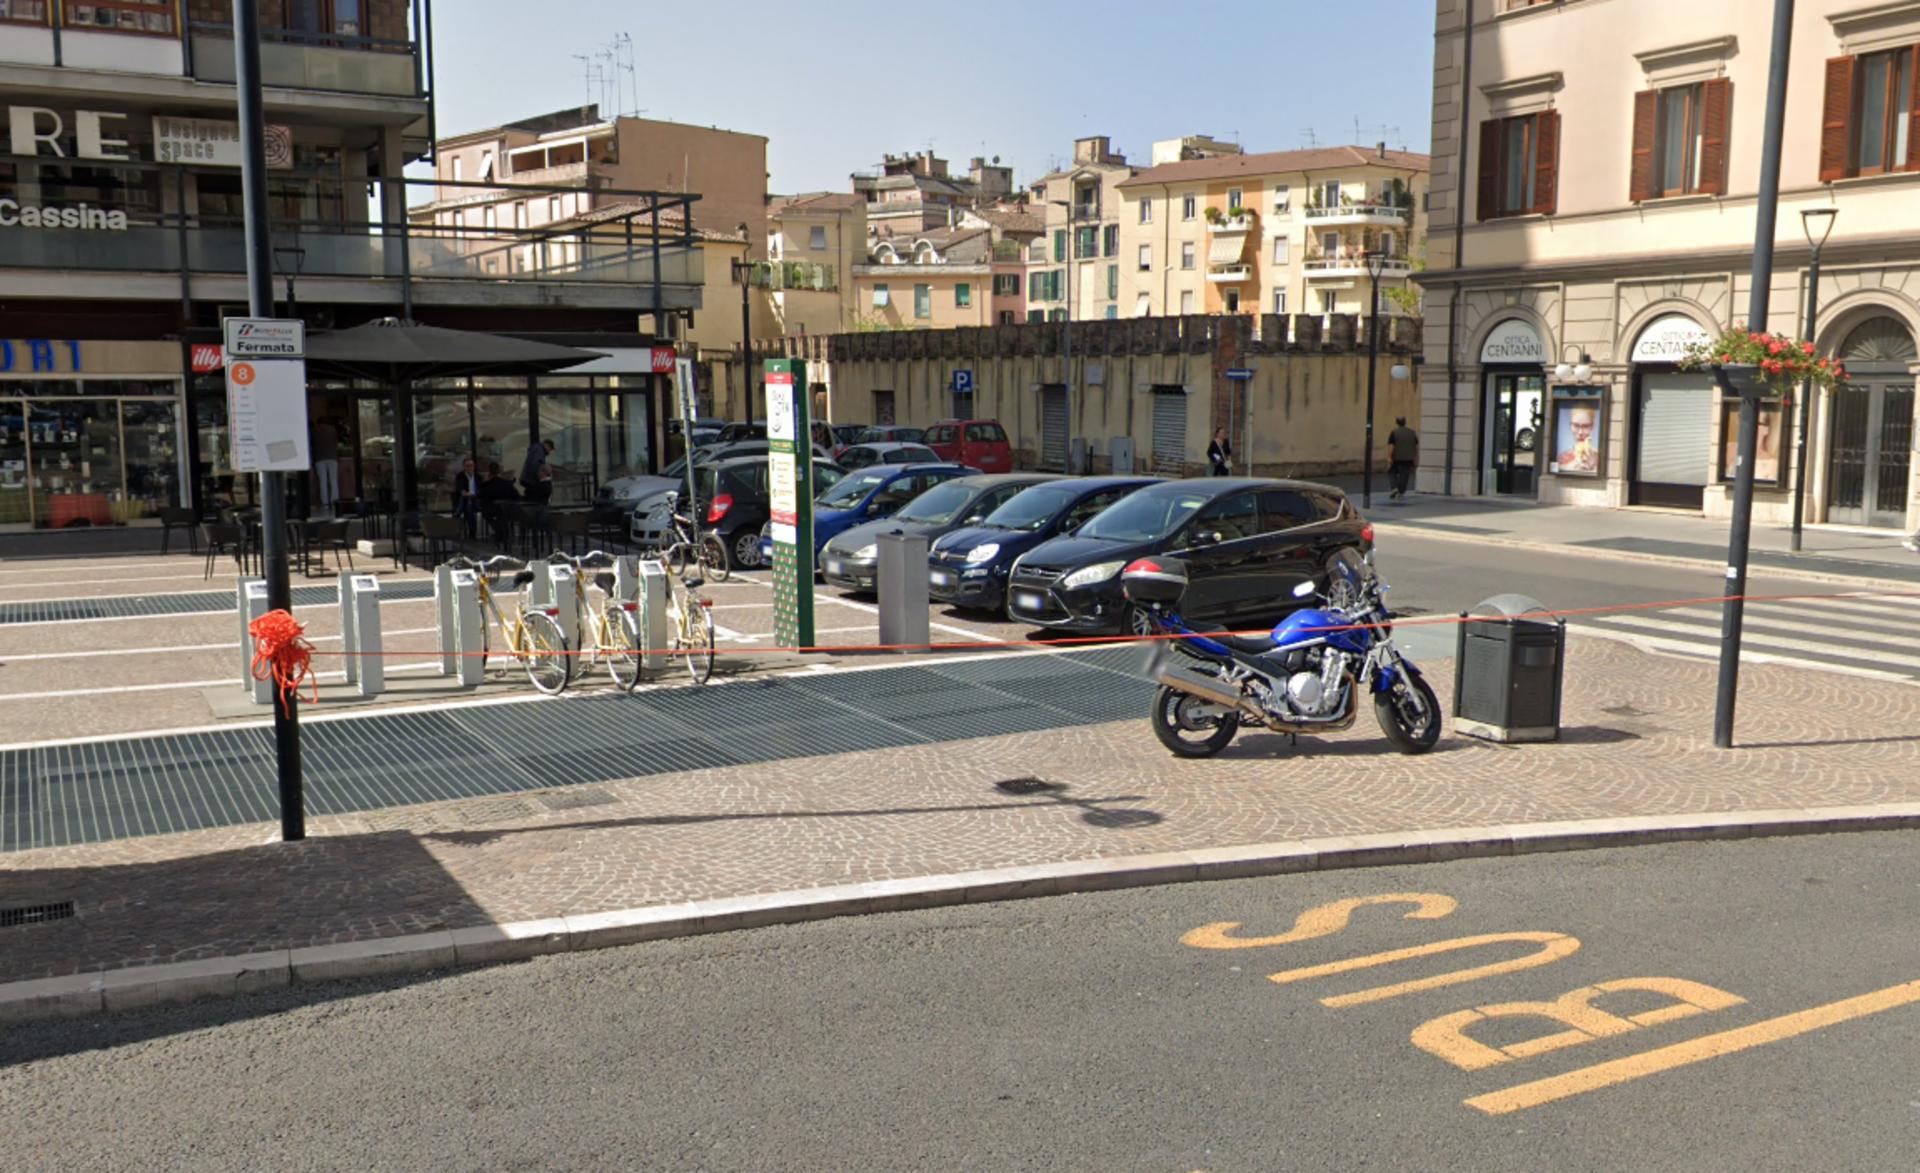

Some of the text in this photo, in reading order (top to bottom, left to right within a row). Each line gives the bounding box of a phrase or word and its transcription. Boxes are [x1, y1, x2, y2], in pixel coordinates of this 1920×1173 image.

[9, 105, 130, 160] RE
[160, 141, 214, 162] space
[0, 198, 127, 230] Cassina
[237, 341, 295, 353] Fermata
[1487, 343, 1542, 357] CENTANNI
[193, 348, 220, 370] illy
[653, 351, 673, 371] illy
[957, 372, 968, 390] P
[1178, 892, 1748, 1072] BUS
